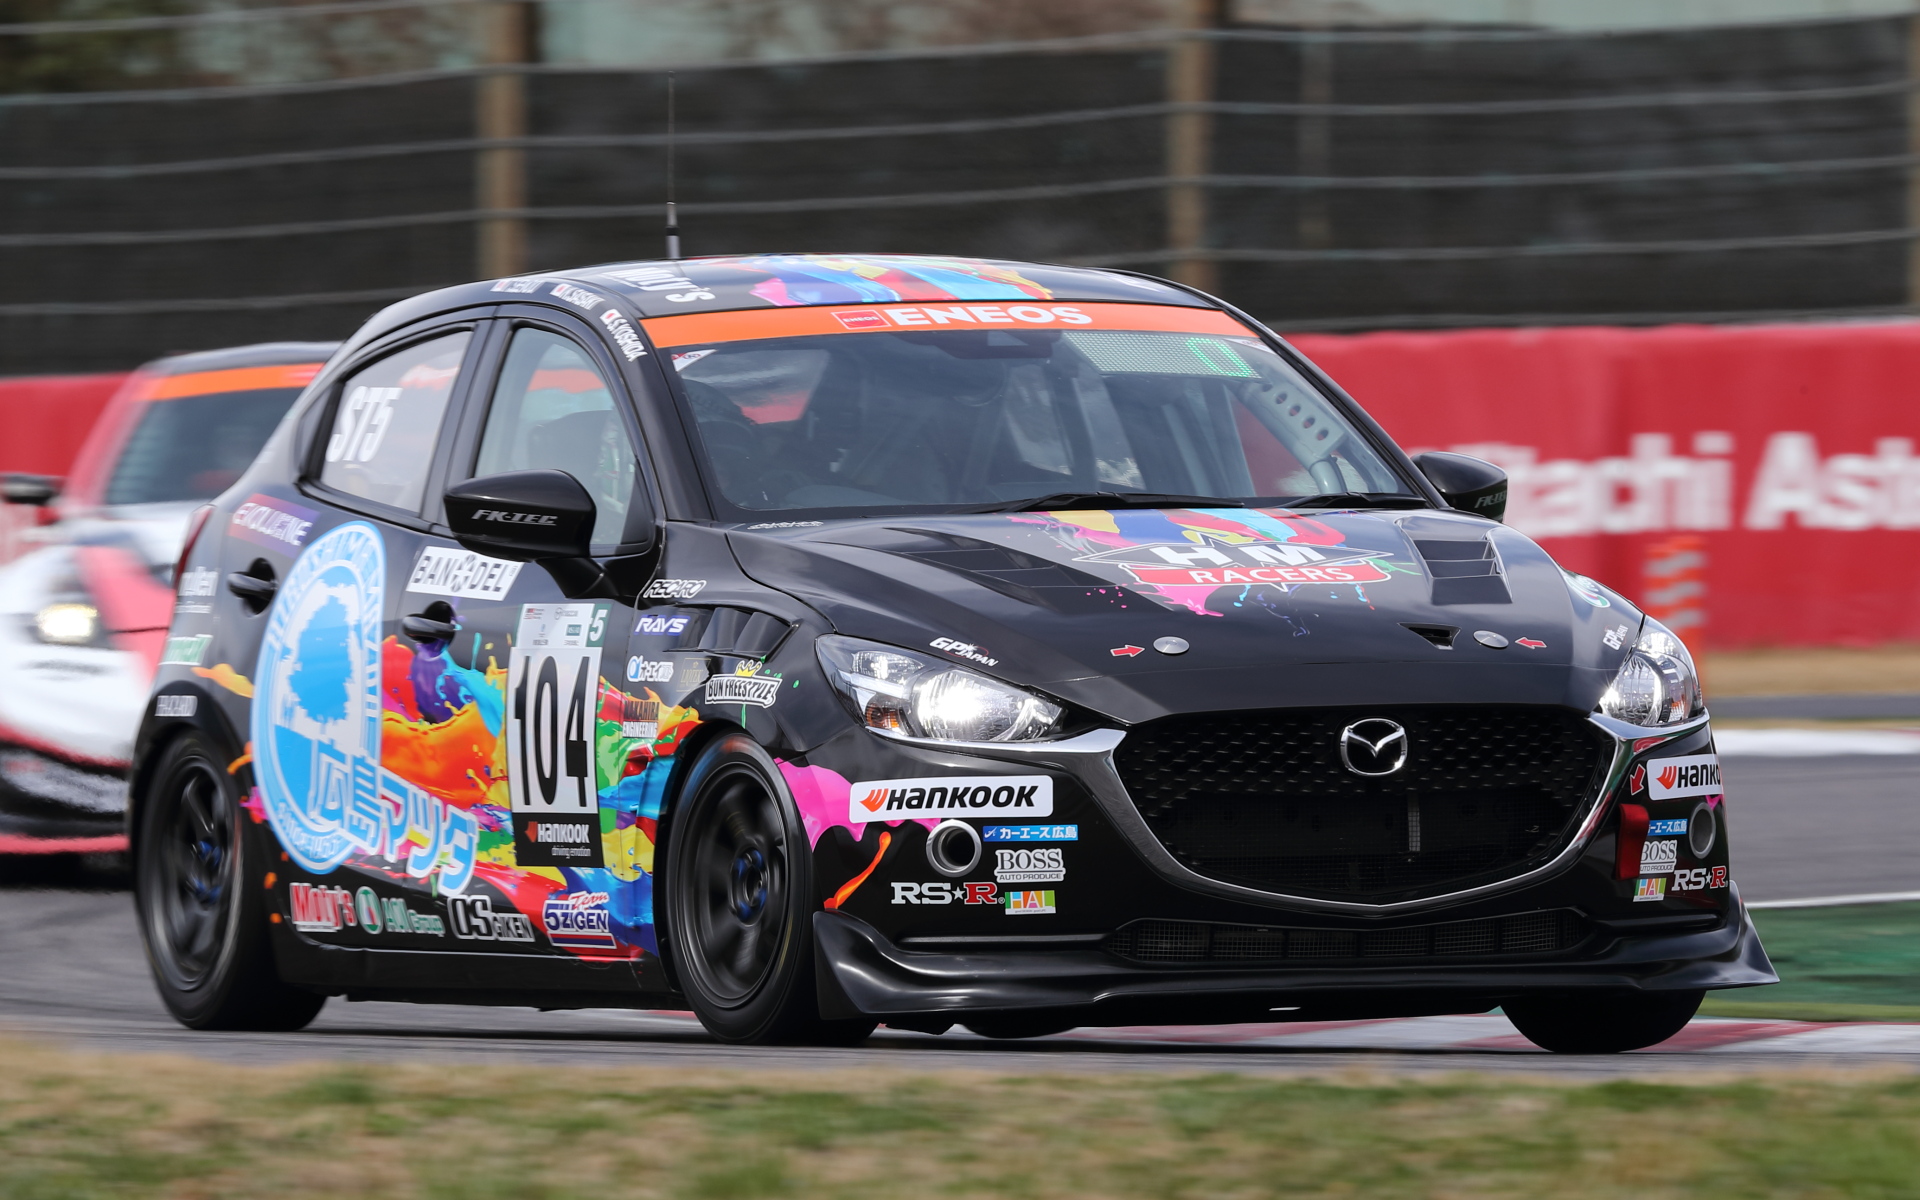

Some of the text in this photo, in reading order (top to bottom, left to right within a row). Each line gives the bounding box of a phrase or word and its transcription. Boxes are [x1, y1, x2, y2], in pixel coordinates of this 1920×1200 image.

[883, 305, 1093, 325] ENEOS
[1188, 567, 1355, 583] RACERS
[643, 579, 707, 598] RECARO
[634, 617, 688, 632] RAYS
[954, 649, 999, 667] JAPAN
[707, 679, 775, 701] BUN FREESTYLE
[514, 655, 591, 808] 104
[1000, 825, 1078, 840] カーエース広島
[998, 850, 1062, 871] BOSS
[570, 892, 609, 910] Team
